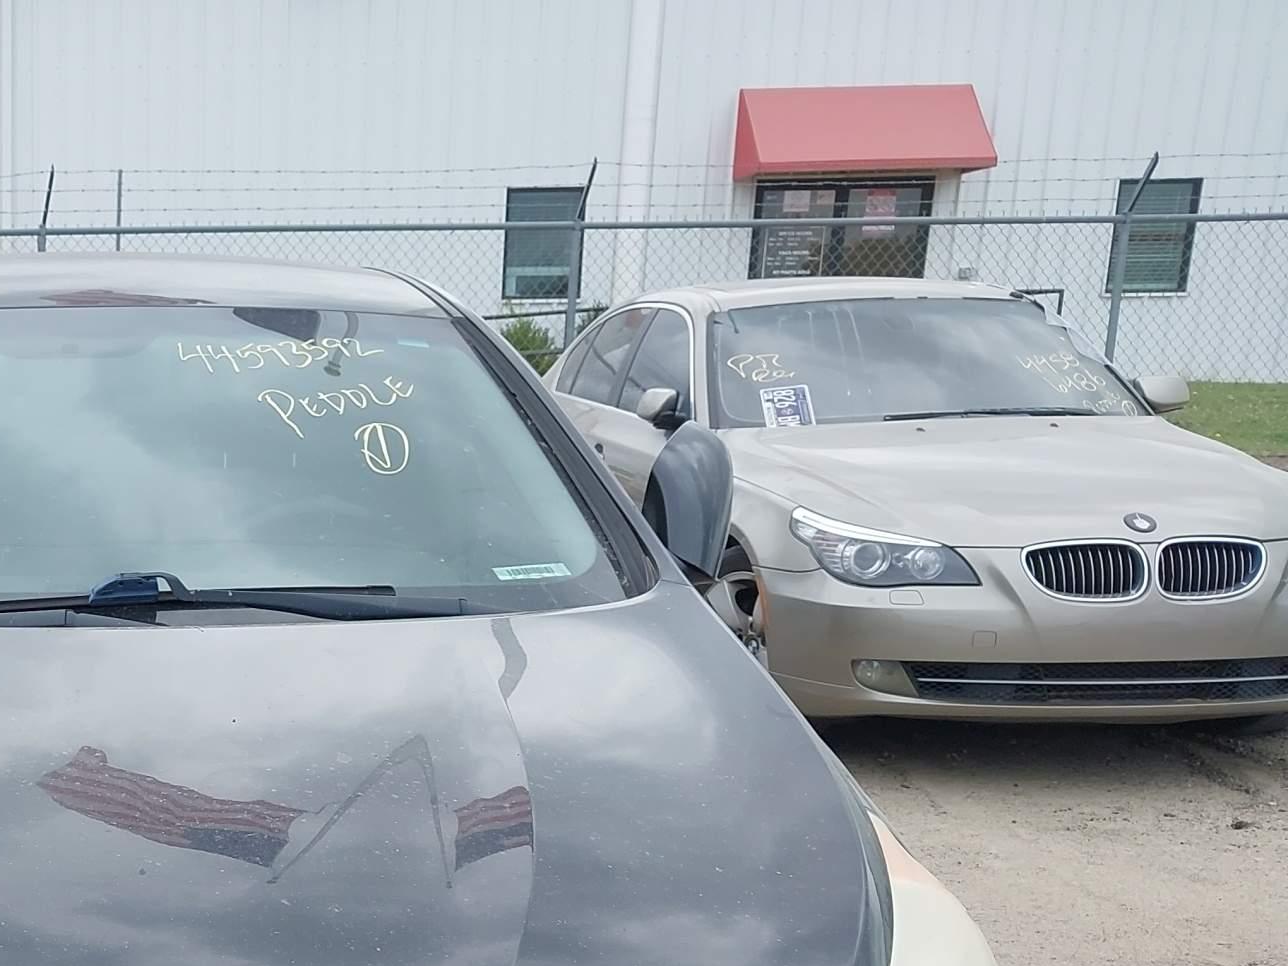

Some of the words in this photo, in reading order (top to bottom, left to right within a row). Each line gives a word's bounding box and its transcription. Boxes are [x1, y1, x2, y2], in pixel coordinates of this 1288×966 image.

[178, 338, 384, 373] 44593592
[258, 376, 414, 438] PEDDLE
[773, 389, 798, 408] 826
